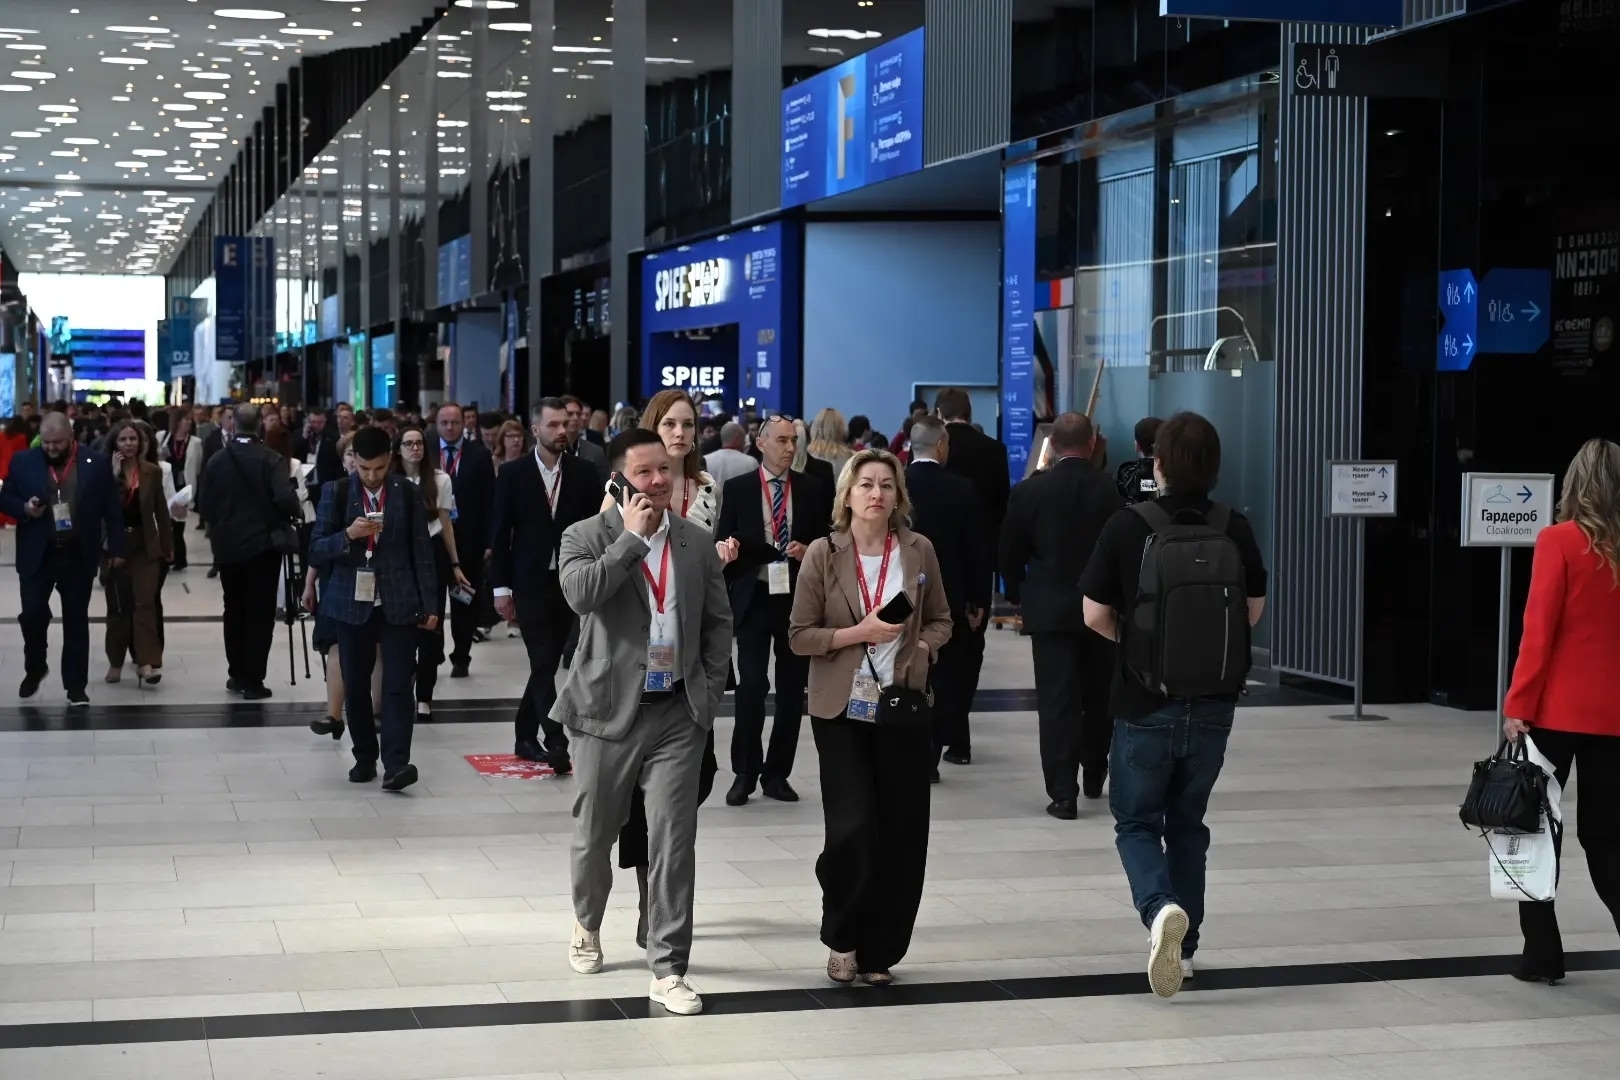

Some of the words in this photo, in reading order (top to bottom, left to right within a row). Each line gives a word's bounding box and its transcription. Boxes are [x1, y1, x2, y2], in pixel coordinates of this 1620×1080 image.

[223, 243, 238, 266] E
[655, 265, 687, 312] SPIEF
[687, 257, 726, 308] SHOP
[172, 350, 190, 362] D2
[661, 365, 725, 387] SPIEF
[1481, 509, 1538, 525] Гардероб
[1486, 525, 1532, 536] Cloakroom
